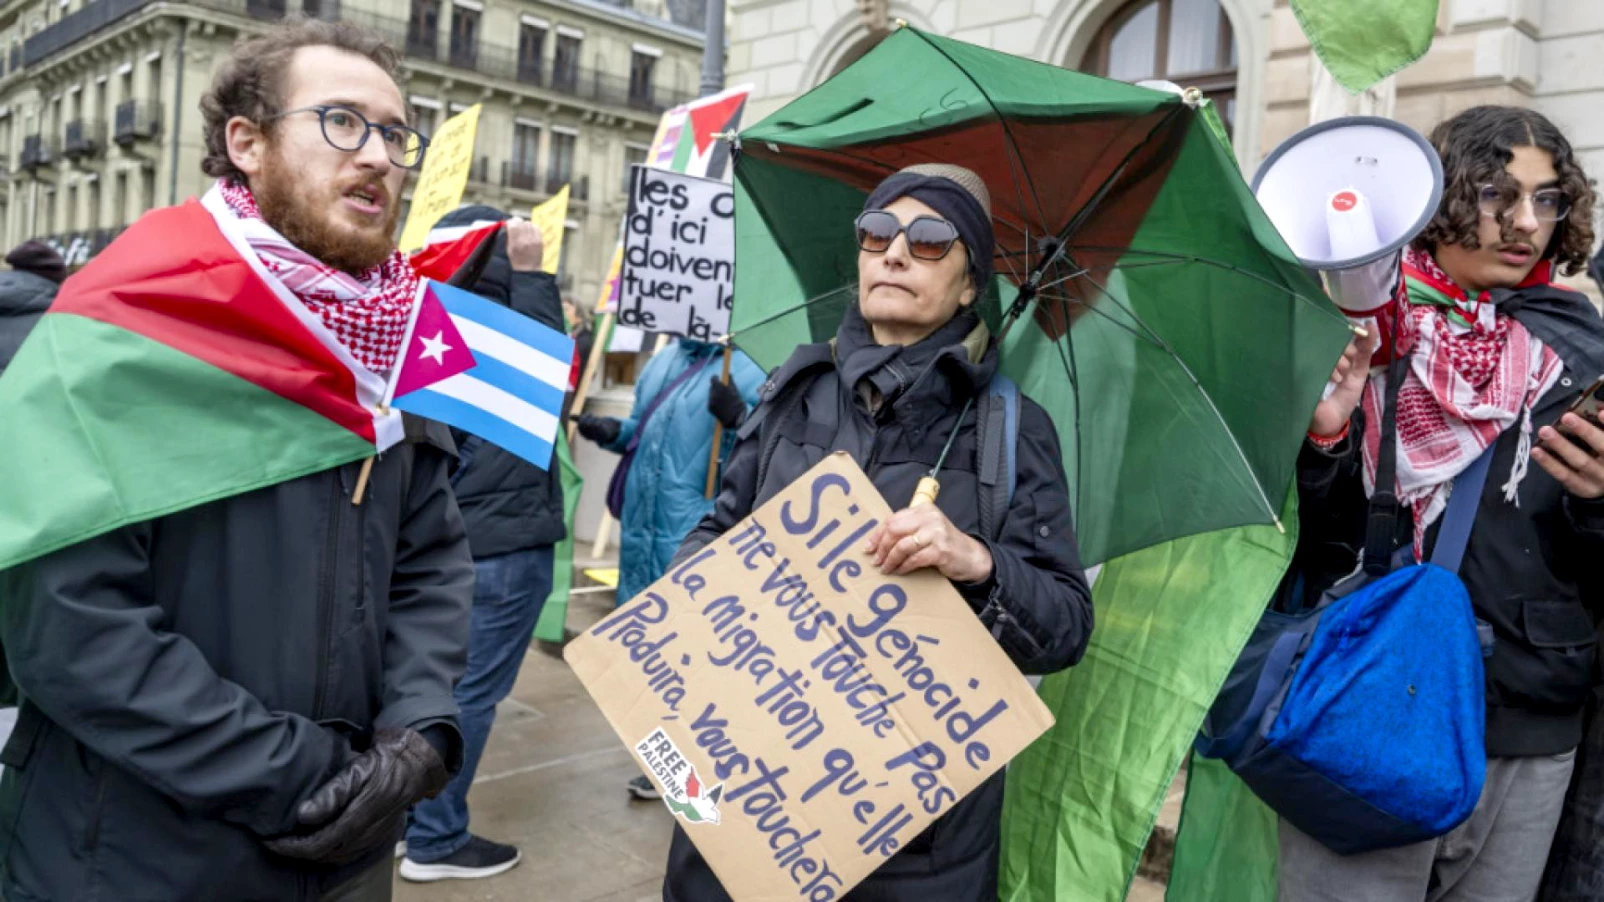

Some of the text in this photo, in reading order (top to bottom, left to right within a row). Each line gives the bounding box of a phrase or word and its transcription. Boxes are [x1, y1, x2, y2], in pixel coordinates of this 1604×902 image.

[639, 168, 689, 211] les
[625, 269, 693, 303] tuer
[622, 296, 656, 328] de
[728, 517, 776, 570] ne
[760, 558, 836, 642] vous
[671, 548, 716, 601] la
[702, 594, 825, 750] migration
[846, 583, 1009, 770] génocide
[637, 743, 684, 799] PALESTINE
[648, 731, 688, 776] FREE
